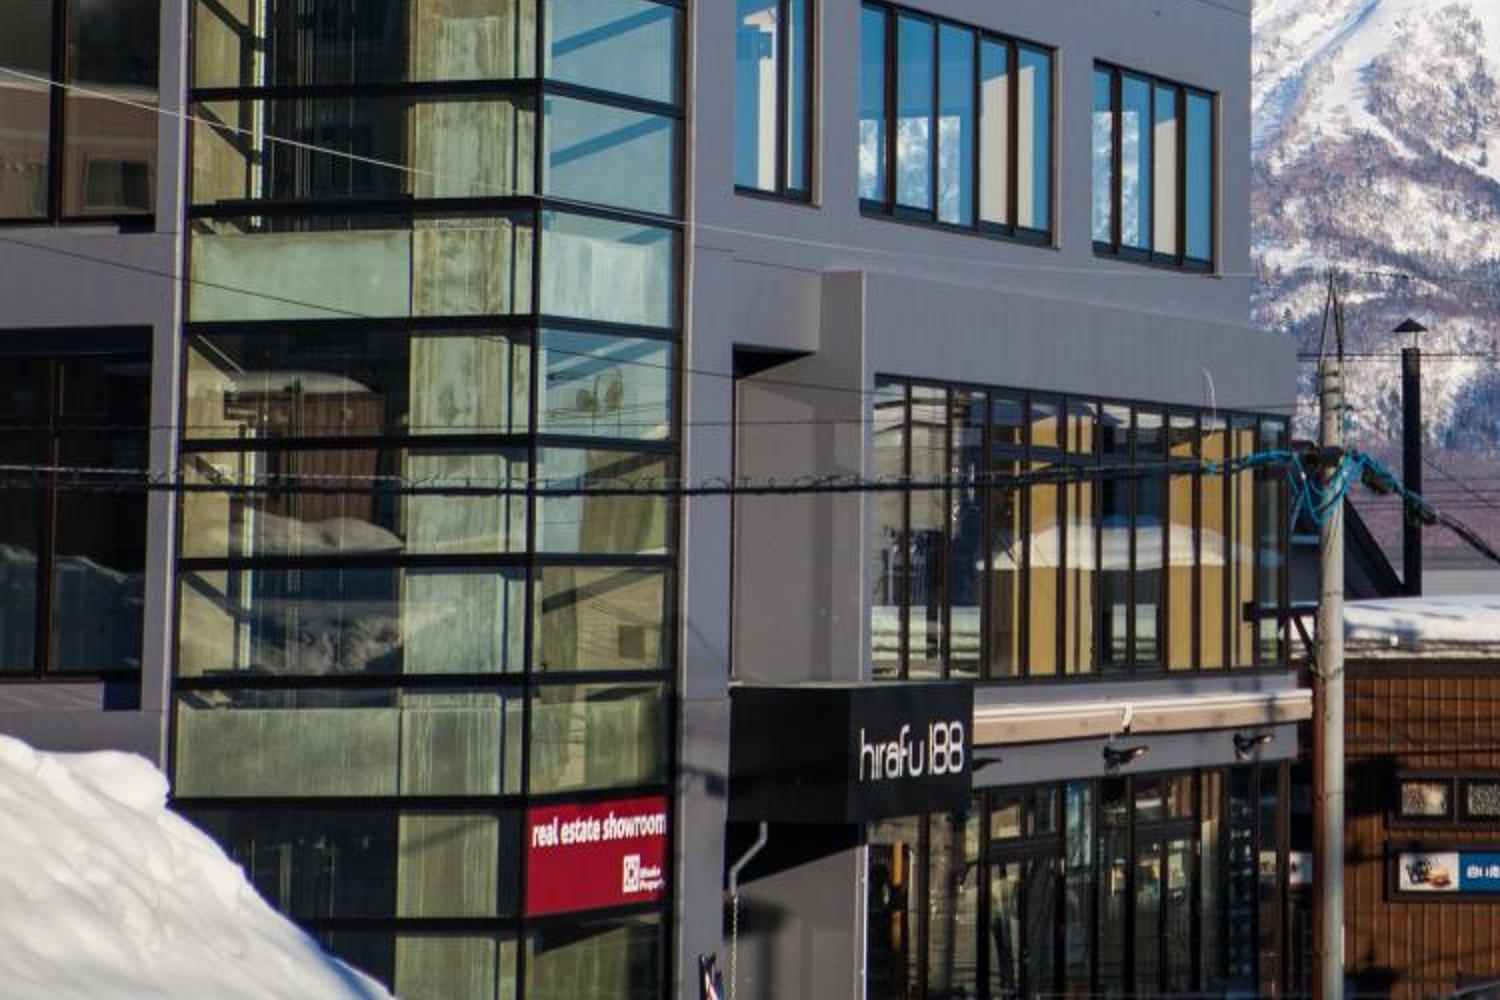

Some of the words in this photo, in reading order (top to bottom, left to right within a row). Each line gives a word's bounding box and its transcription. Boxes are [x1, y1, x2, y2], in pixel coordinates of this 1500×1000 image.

[859, 723, 924, 781] hirafu
[928, 721, 964, 775] 188
[532, 817, 559, 848] real
[560, 816, 601, 845] estate
[602, 811, 667, 840] showroom
